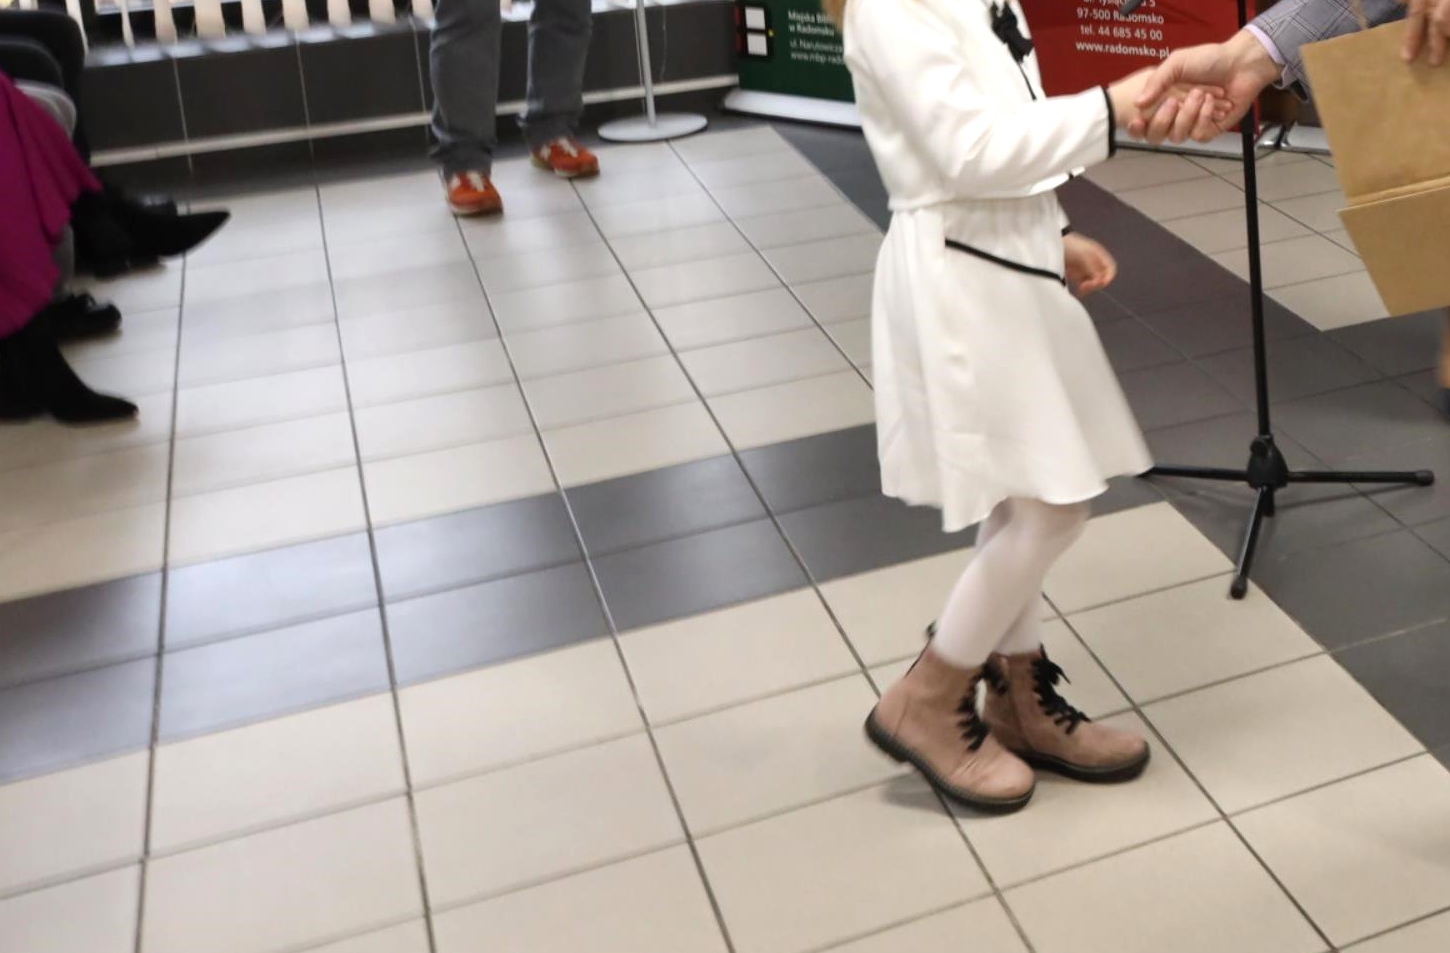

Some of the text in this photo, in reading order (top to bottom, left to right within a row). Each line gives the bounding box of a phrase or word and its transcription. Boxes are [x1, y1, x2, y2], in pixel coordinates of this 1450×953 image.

[1077, 7, 1111, 21] 97-500
[1080, 24, 1163, 41] tel. 44 685 45 00
[1076, 41, 1170, 59] www.radomsko.pl
